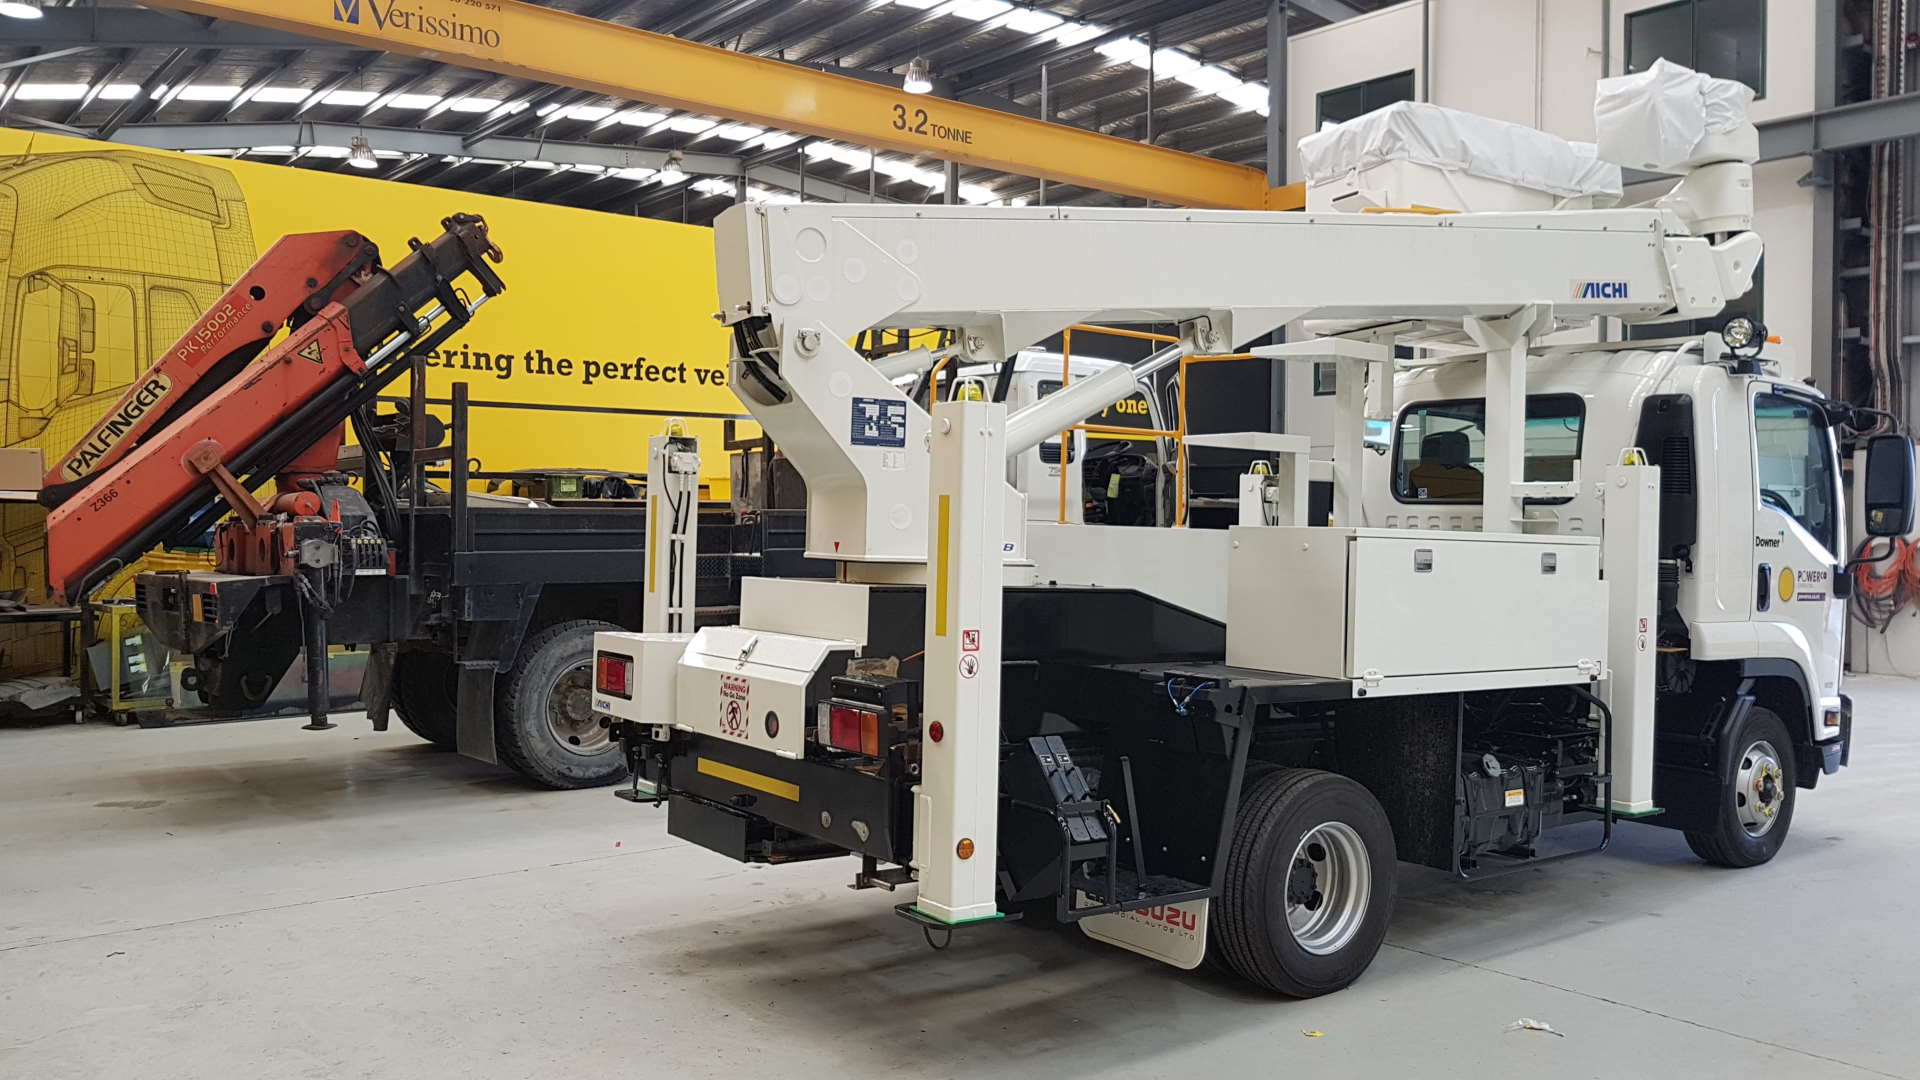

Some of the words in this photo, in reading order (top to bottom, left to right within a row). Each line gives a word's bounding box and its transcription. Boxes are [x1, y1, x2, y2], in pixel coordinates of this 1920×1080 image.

[366, 0, 501, 48] Verissimo
[892, 103, 929, 136] 3.2
[930, 123, 973, 145] TONNE
[1580, 281, 1629, 299] AICHI
[176, 340, 200, 362] PK
[195, 303, 237, 344] 15002
[200, 303, 253, 354] Performance
[425, 344, 514, 380] ering
[523, 349, 573, 377] the
[582, 357, 687, 385] perfect
[694, 363, 729, 387] ve
[1116, 398, 1148, 415] one
[66, 379, 167, 477] PALFINGER
[89, 488, 118, 512] Z366
[1755, 536, 1780, 549] Downer
[1136, 903, 1196, 931] UZU
